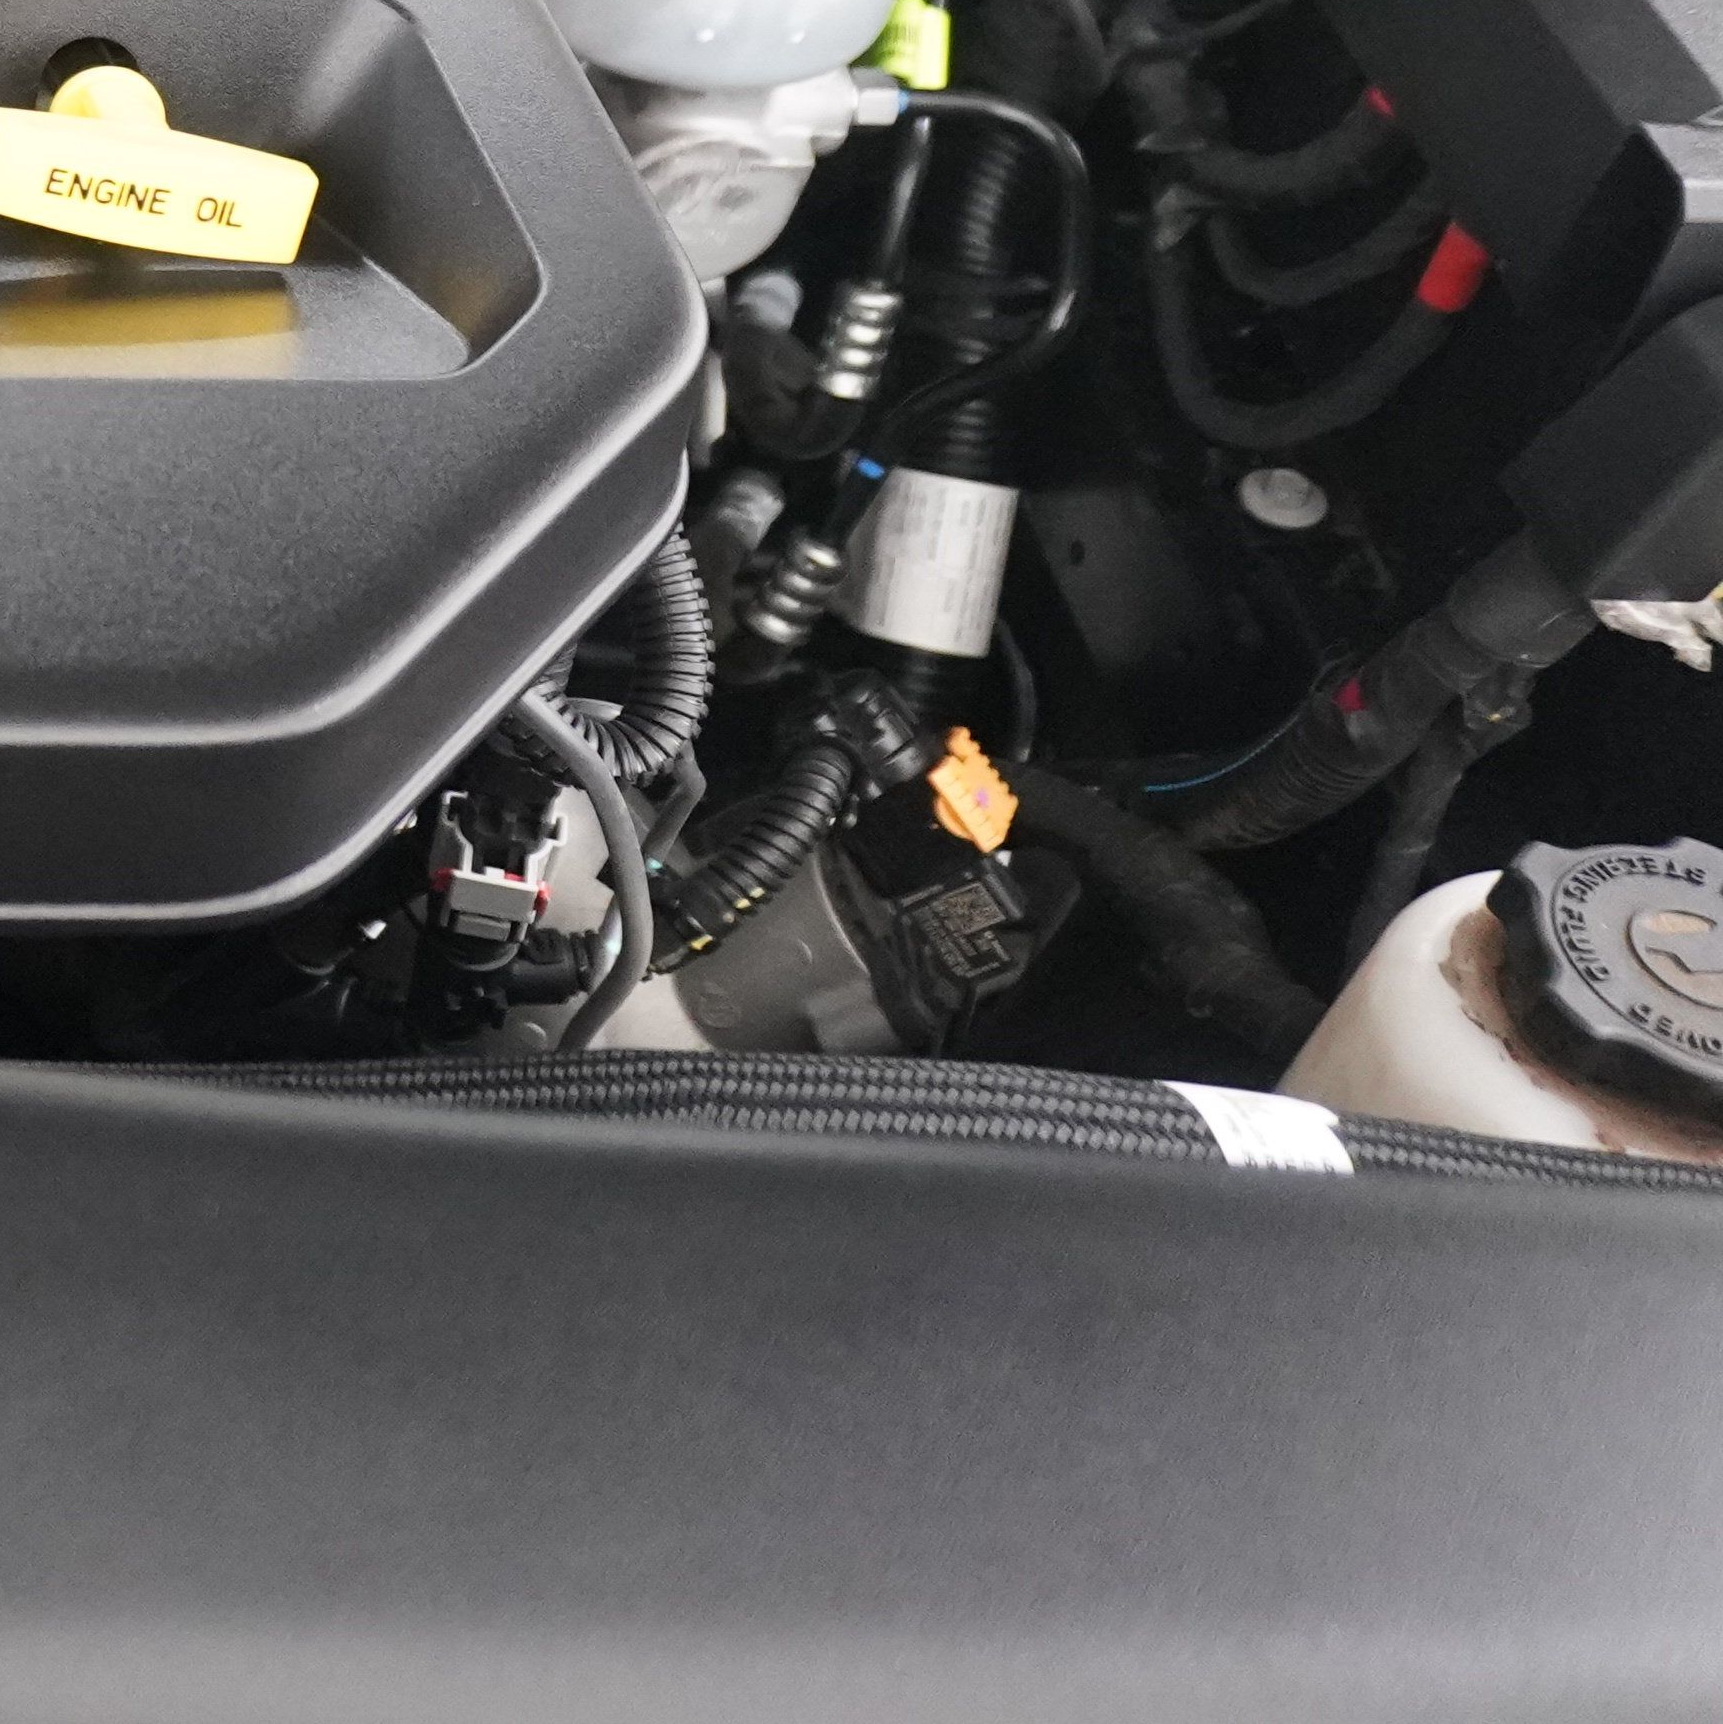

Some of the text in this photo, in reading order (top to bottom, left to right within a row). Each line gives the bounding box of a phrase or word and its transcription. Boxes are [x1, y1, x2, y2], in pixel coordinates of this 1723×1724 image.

[44, 168, 243, 228] ENGINE OIL
[1562, 855, 1707, 904] STEERING
[1560, 904, 1611, 982] FLUID
